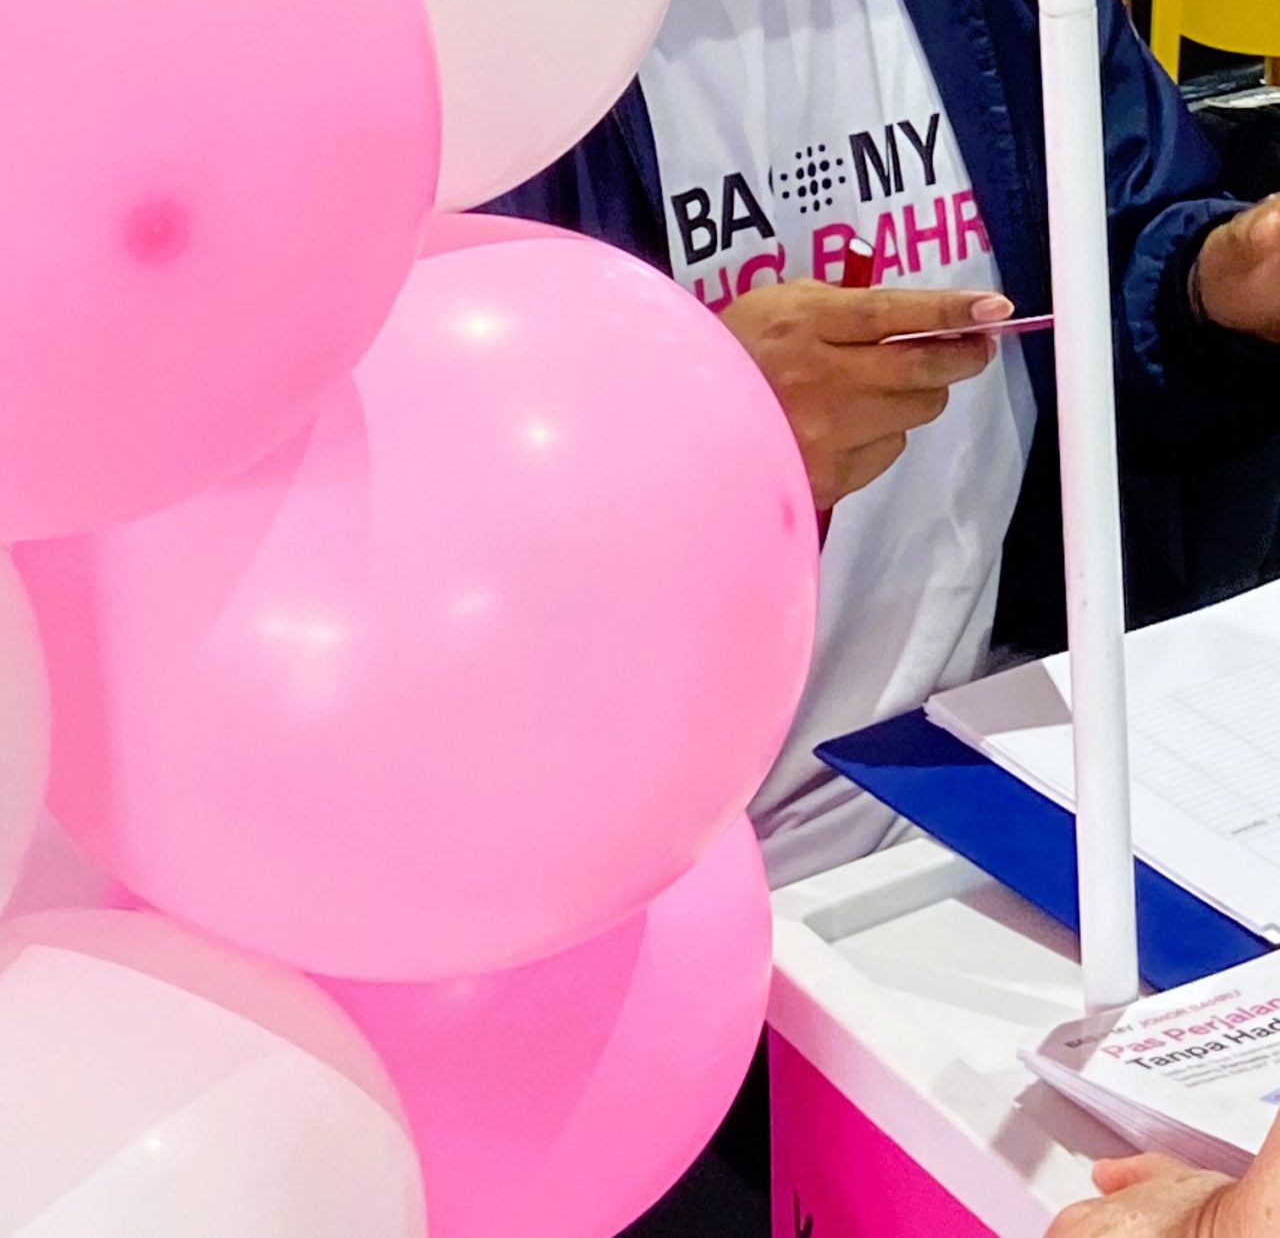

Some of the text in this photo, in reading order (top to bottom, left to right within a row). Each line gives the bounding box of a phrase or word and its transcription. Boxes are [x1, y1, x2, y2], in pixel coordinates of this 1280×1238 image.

[670, 113, 940, 265] BA MY
[1101, 1035, 1166, 1059] Pas
[1124, 1040, 1228, 1071] Tanpa
